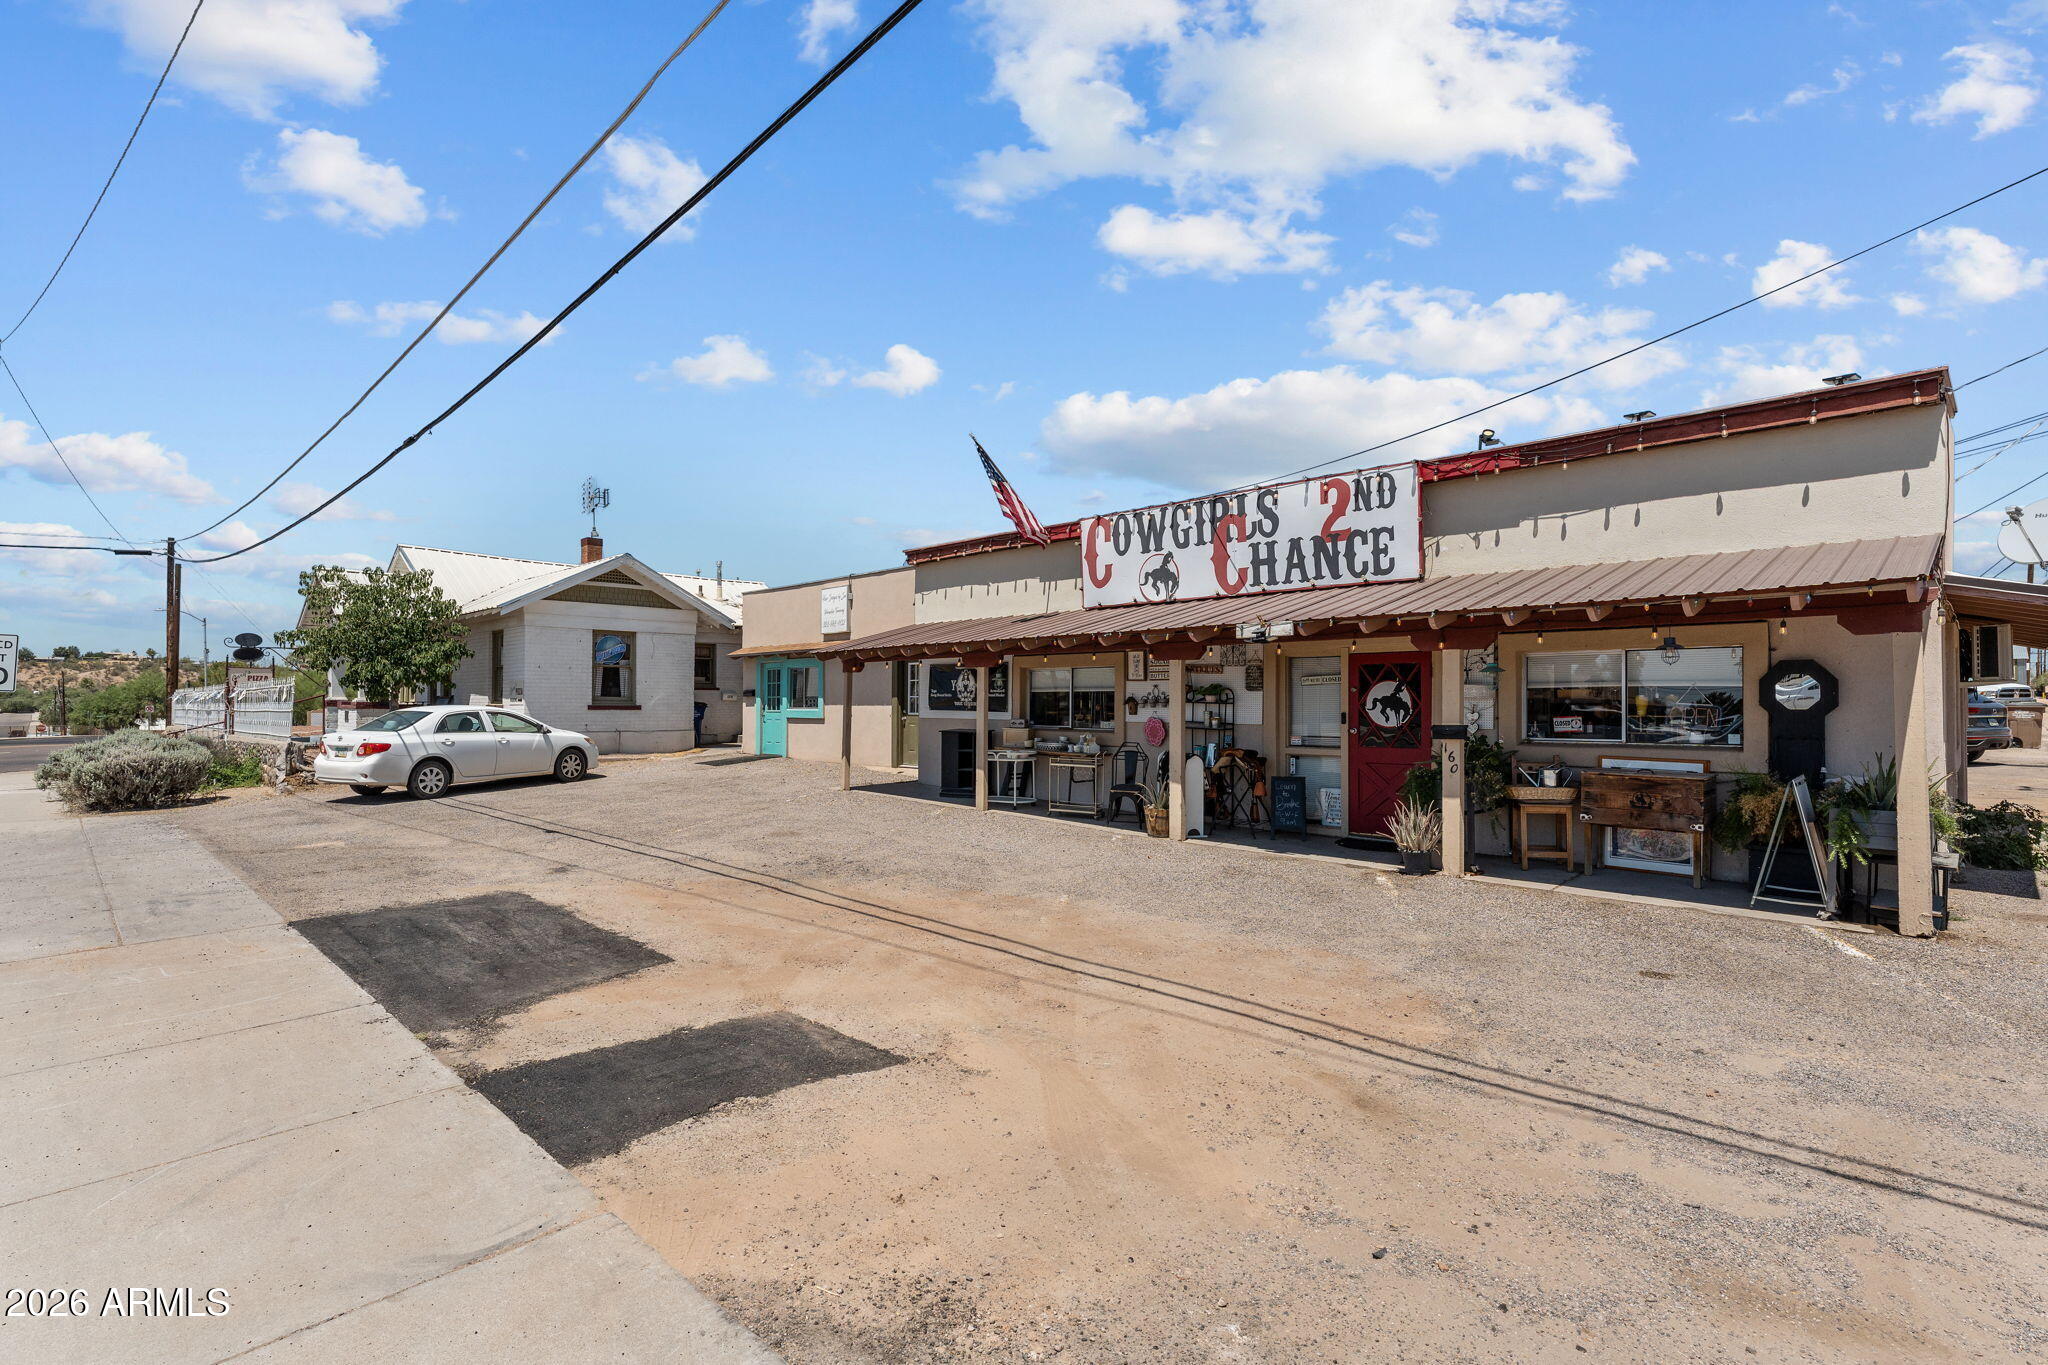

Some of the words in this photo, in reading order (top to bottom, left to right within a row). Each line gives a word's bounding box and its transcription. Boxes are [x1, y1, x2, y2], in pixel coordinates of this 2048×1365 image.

[1319, 472, 1397, 543] 2ND
[1210, 513, 1396, 595] CHANCE
[1669, 706, 1719, 728] OPEN
